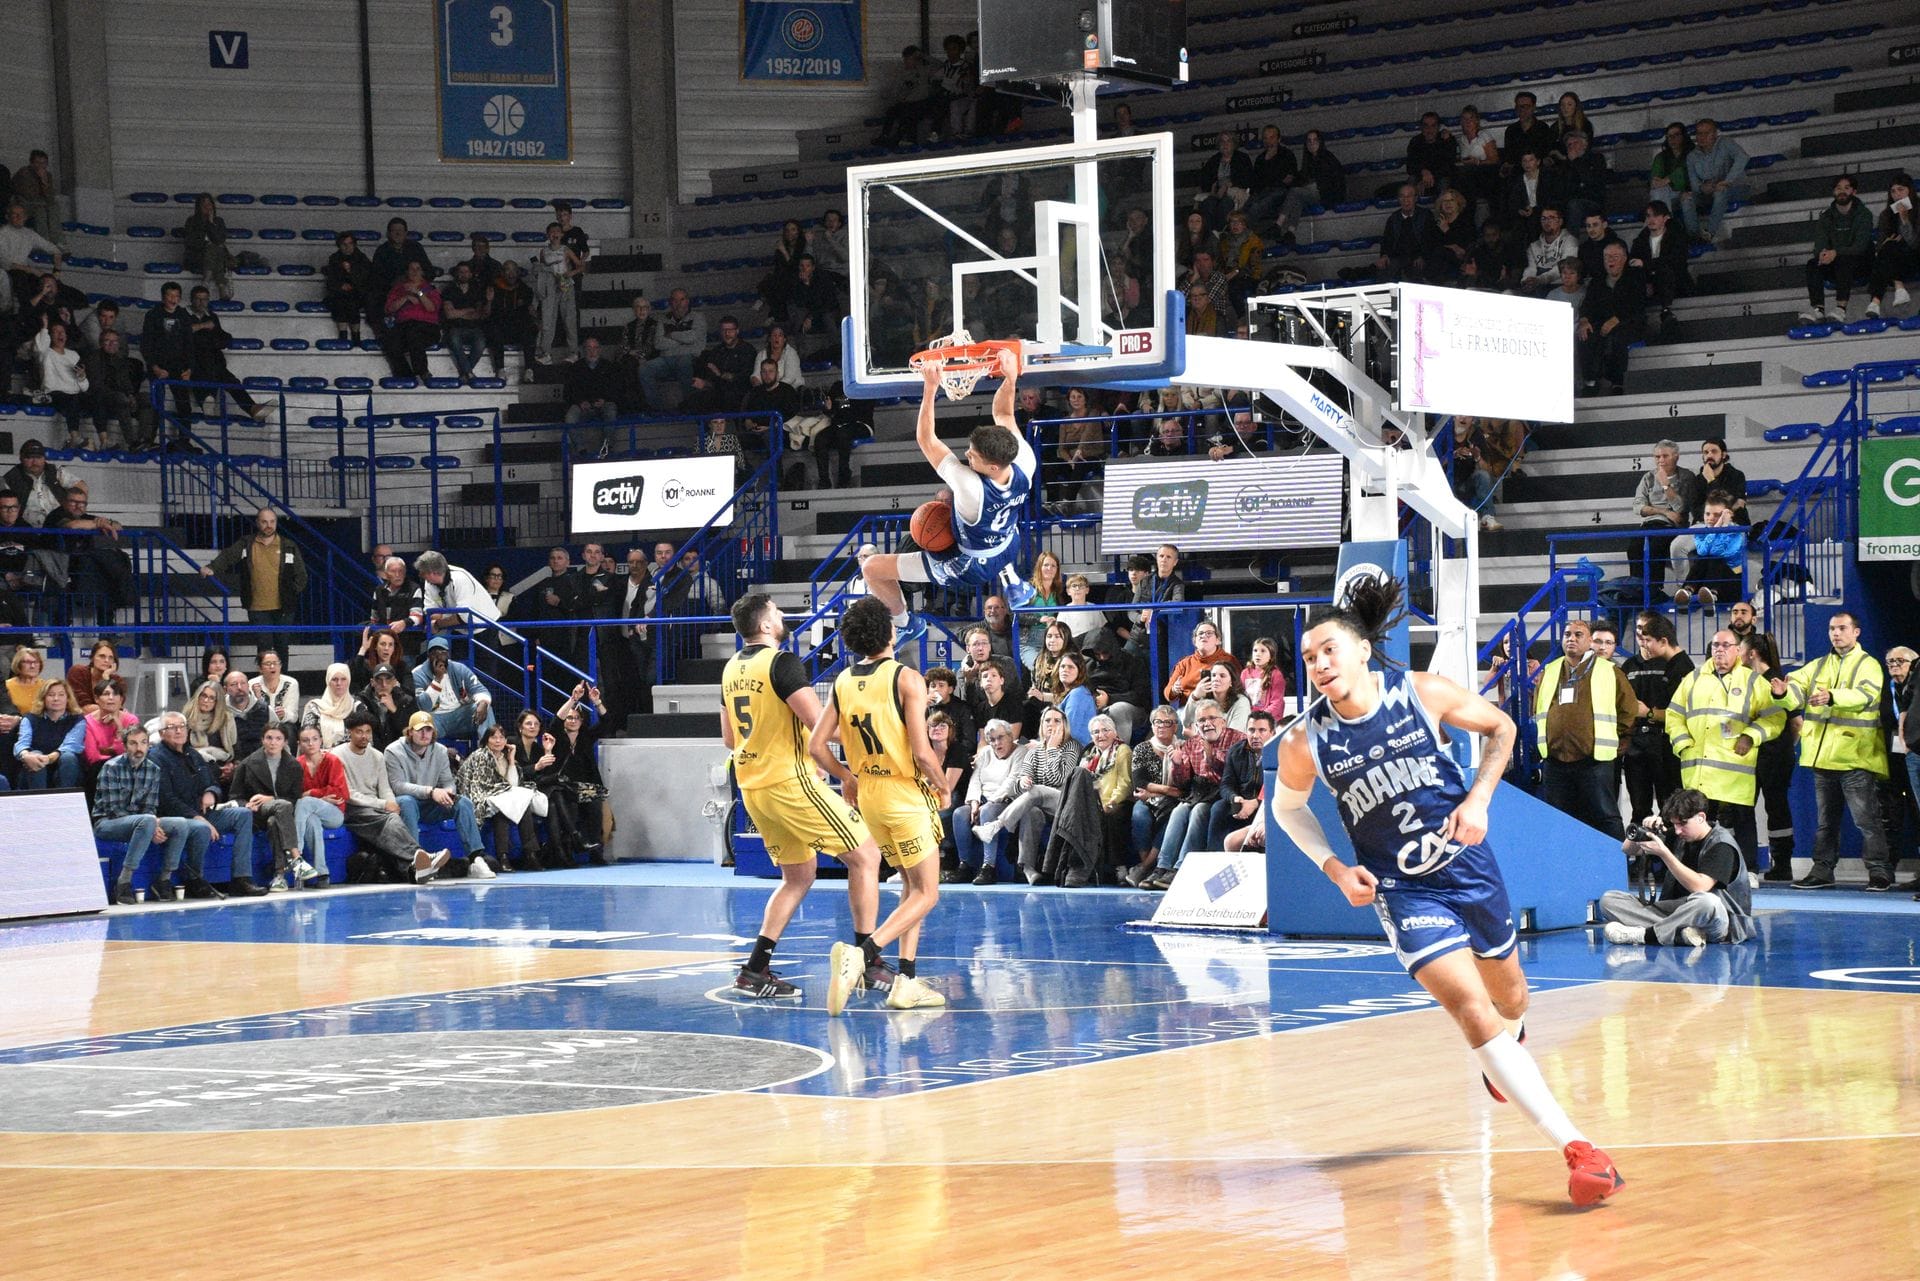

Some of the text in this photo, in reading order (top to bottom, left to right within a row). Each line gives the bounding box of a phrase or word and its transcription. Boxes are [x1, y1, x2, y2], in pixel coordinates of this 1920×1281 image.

[490, 5, 513, 46] 3
[214, 34, 242, 65] V
[766, 58, 841, 75] 1952/2019
[466, 140, 545, 157] 1942/1962
[1467, 334, 1549, 359] FRAMBOISINE
[1310, 392, 1344, 424] MARTY
[1669, 404, 1678, 417] 6
[1632, 458, 1641, 471] 5
[597, 483, 717, 506] activ 101 ROANNE
[1138, 489, 1202, 519] activ
[1269, 495, 1316, 509] ROANNE
[725, 678, 764, 696] SANCHEZ
[733, 696, 753, 740] 5
[850, 712, 884, 755] 11
[1387, 728, 1426, 748] Roanne
[1341, 755, 1445, 826] ROANNE
[1391, 801, 1424, 834] 2
[1162, 906, 1257, 920] Girerd Distribution
[1401, 915, 1457, 931] PROMAN
[850, 1011, 1328, 1087] AUTOMOBILE
